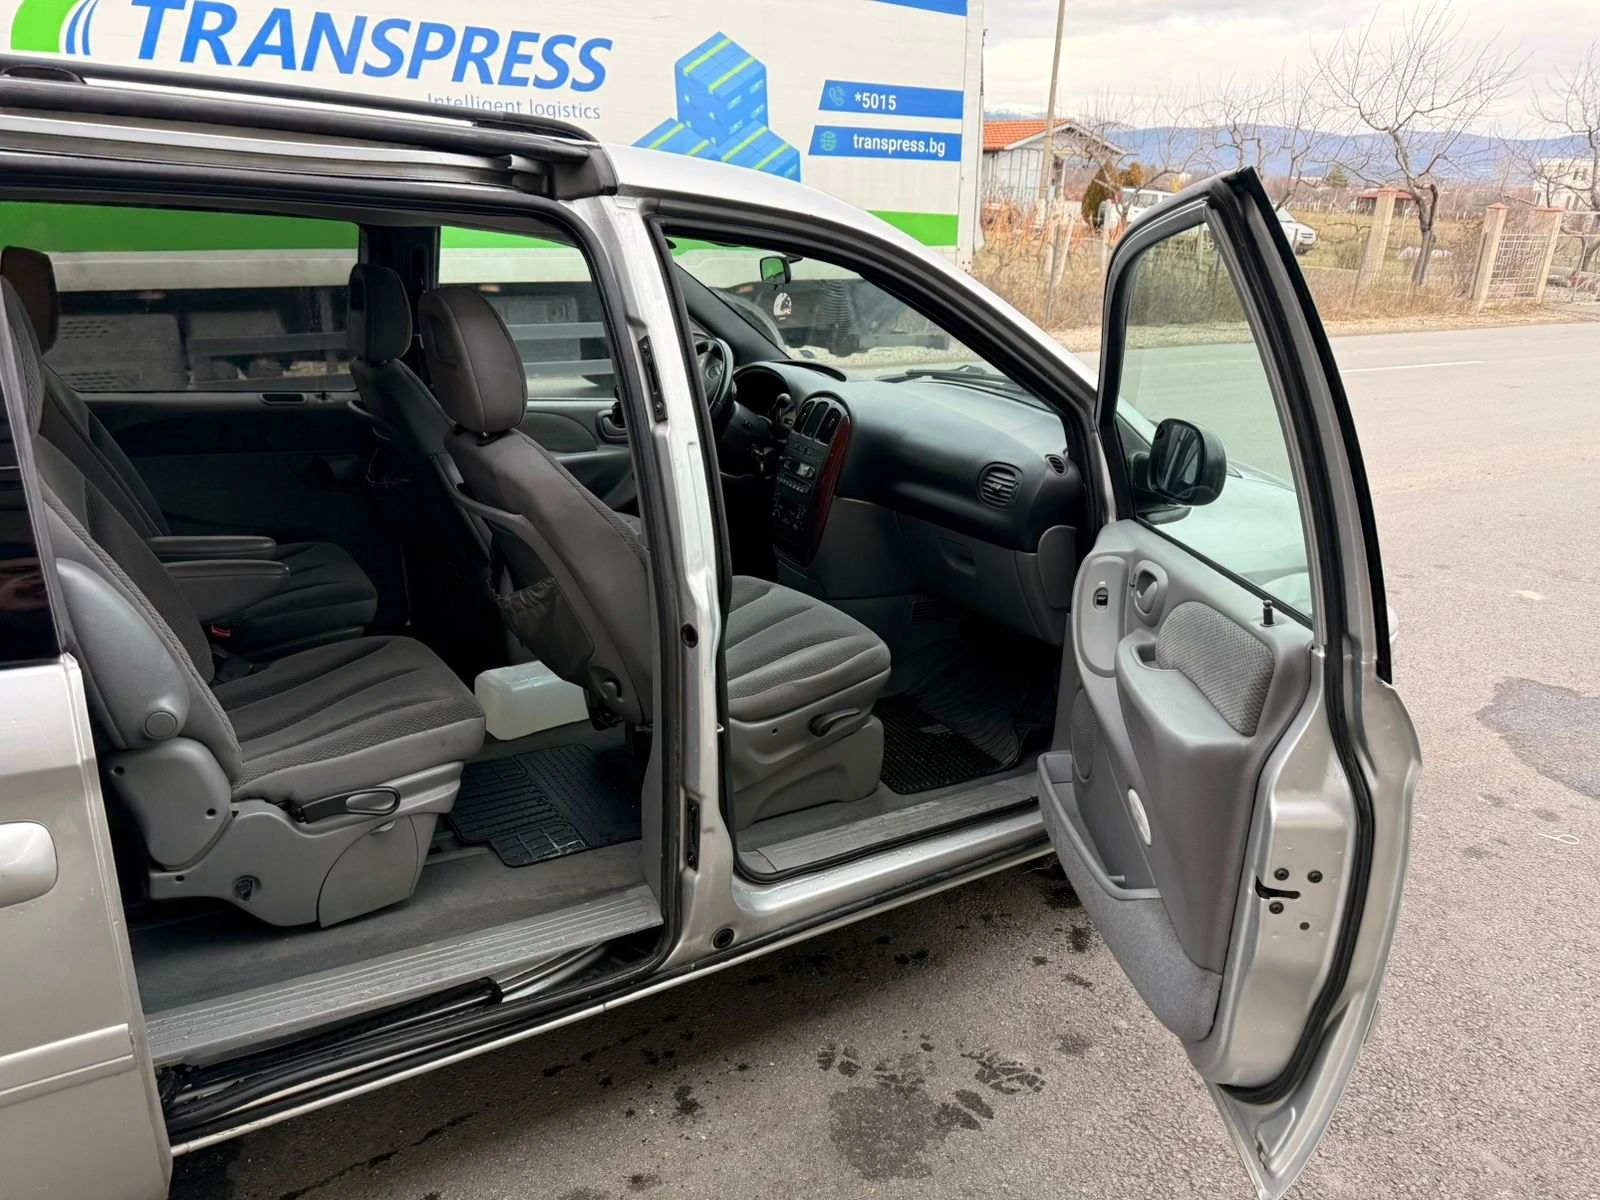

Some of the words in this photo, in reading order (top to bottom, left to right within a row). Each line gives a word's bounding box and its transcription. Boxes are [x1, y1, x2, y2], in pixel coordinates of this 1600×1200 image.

[131, 0, 613, 92] TRANSPRESS
[529, 99, 601, 119] logistics
[853, 133, 945, 157] transpress.bg
